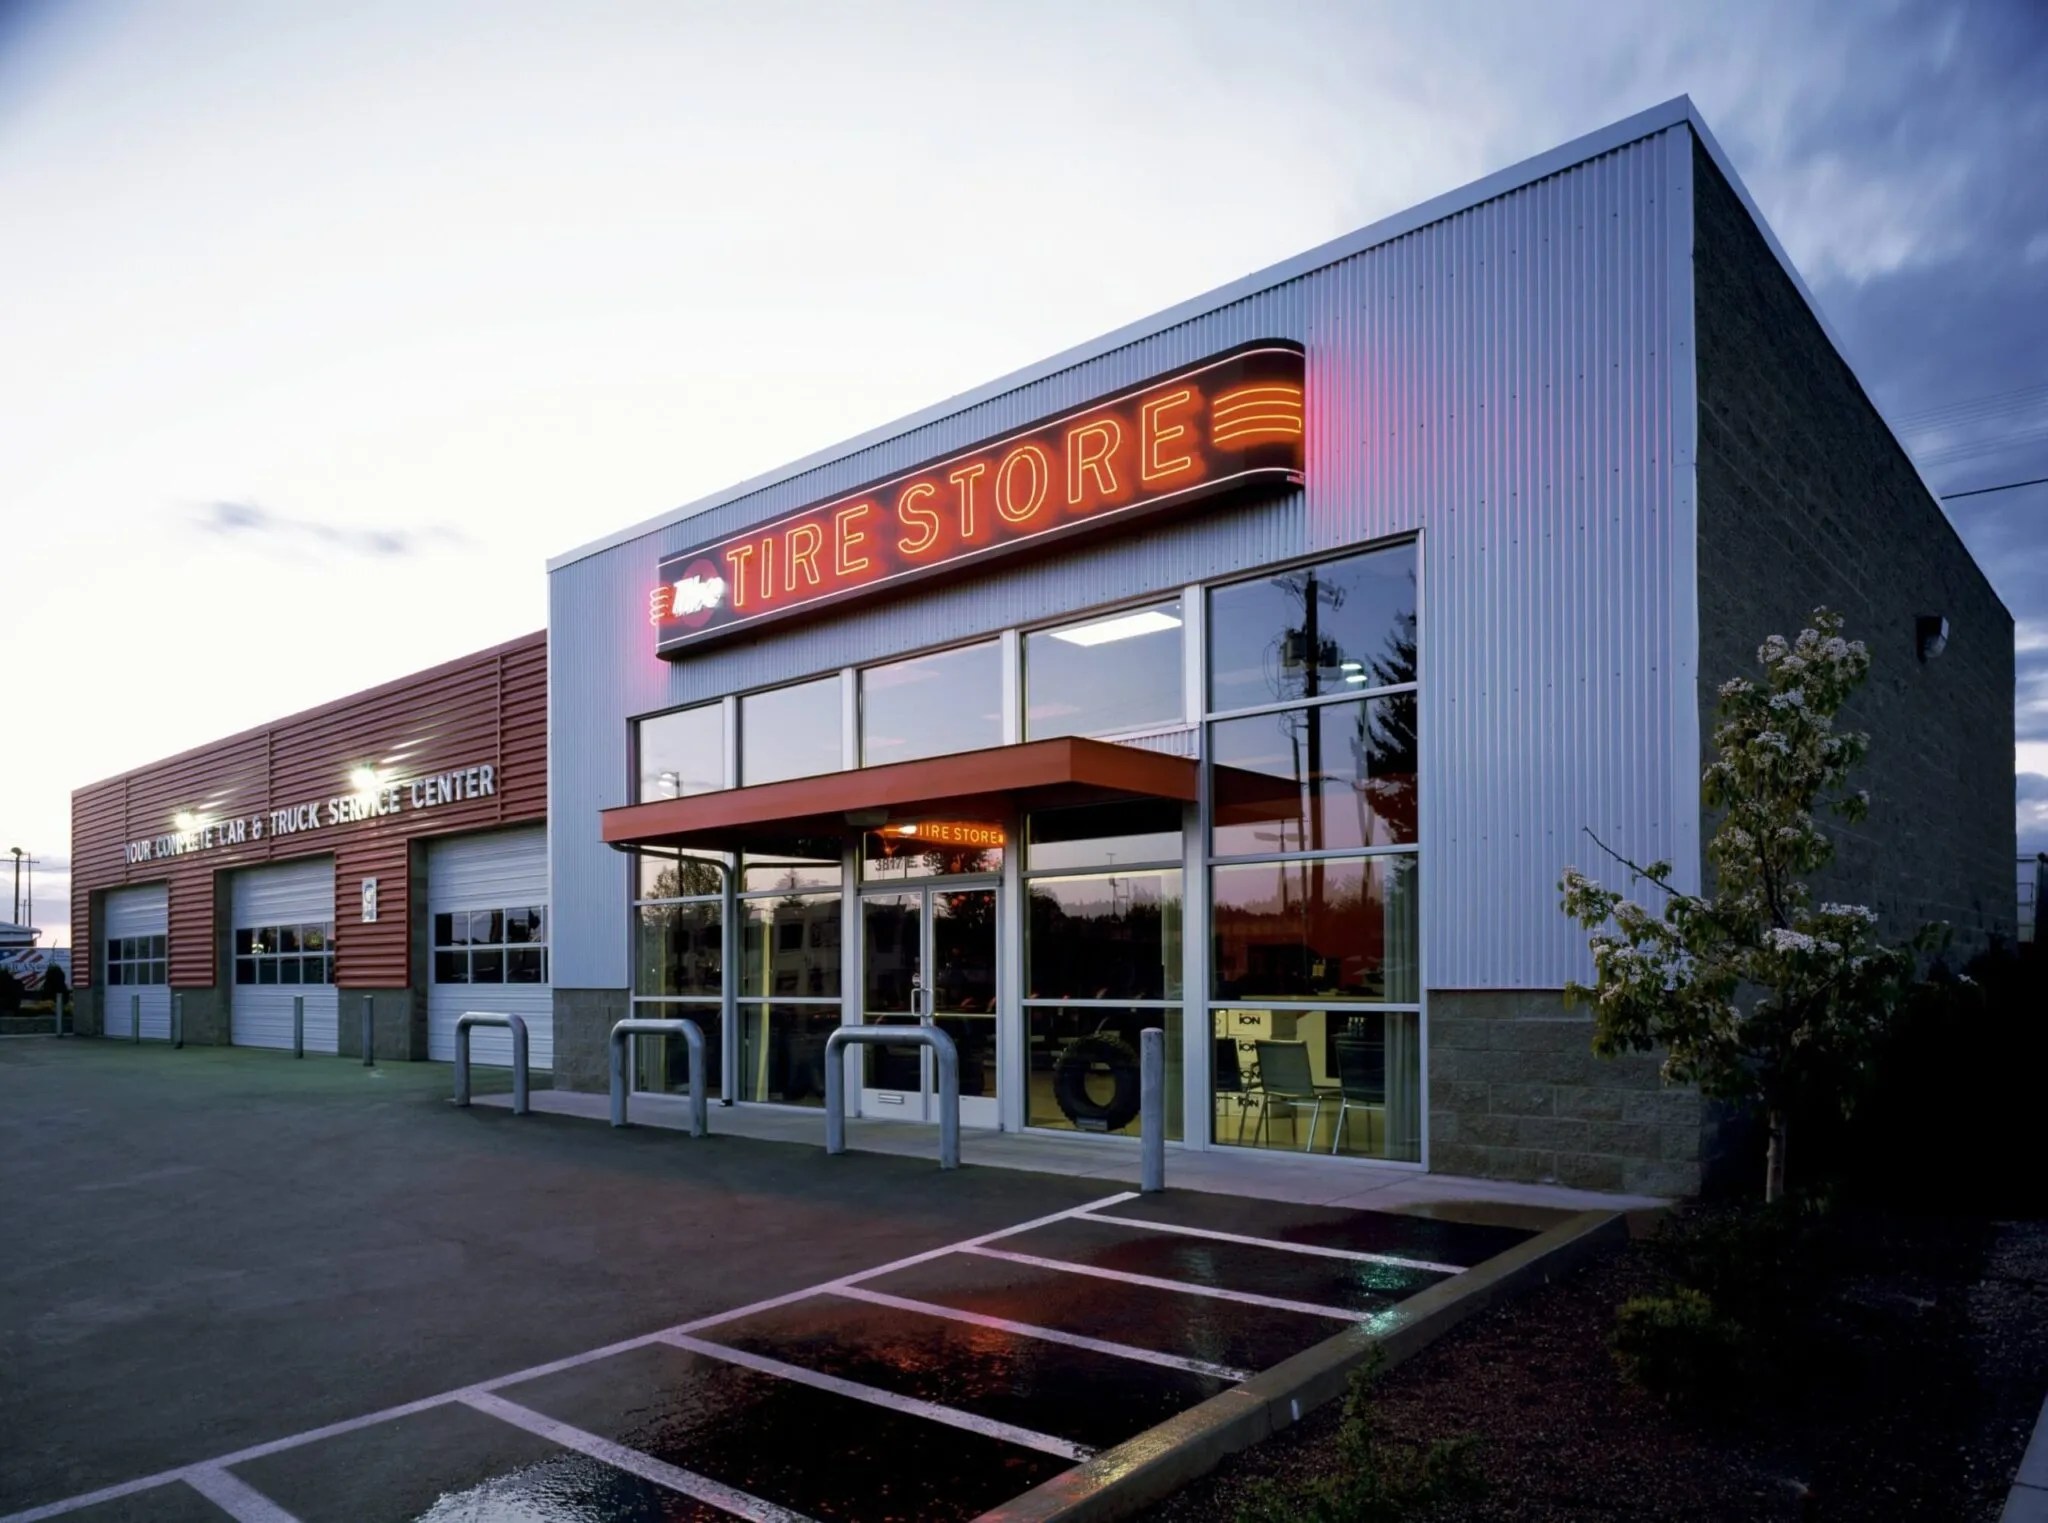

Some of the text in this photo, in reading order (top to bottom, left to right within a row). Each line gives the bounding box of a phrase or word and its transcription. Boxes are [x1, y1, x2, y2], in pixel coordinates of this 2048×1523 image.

[726, 503, 869, 607] TIRE
[898, 389, 1193, 555] STORE
[124, 840, 152, 864] YOUR
[219, 819, 246, 846] CAR
[252, 815, 263, 840] &
[270, 802, 321, 837] TRUCK
[328, 784, 401, 826] SERVICE
[411, 764, 496, 809] CENTER
[954, 827, 998, 844] STORE
